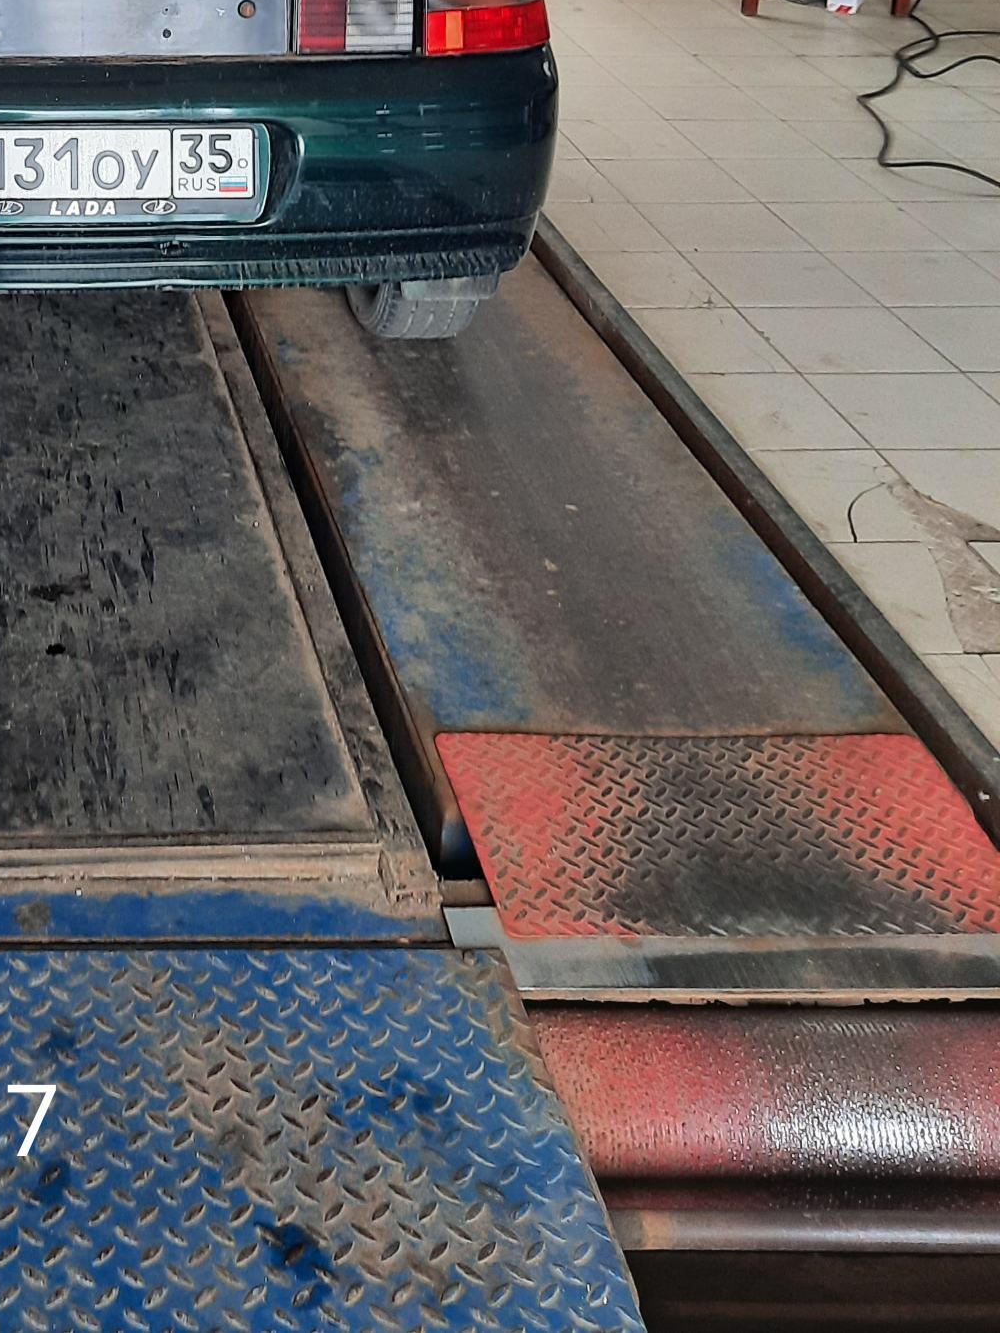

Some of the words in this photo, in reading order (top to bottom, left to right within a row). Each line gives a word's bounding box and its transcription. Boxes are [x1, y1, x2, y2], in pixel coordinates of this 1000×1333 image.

[179, 133, 234, 175] 35
[178, 176, 217, 193] RUS
[49, 200, 117, 216] LADA
